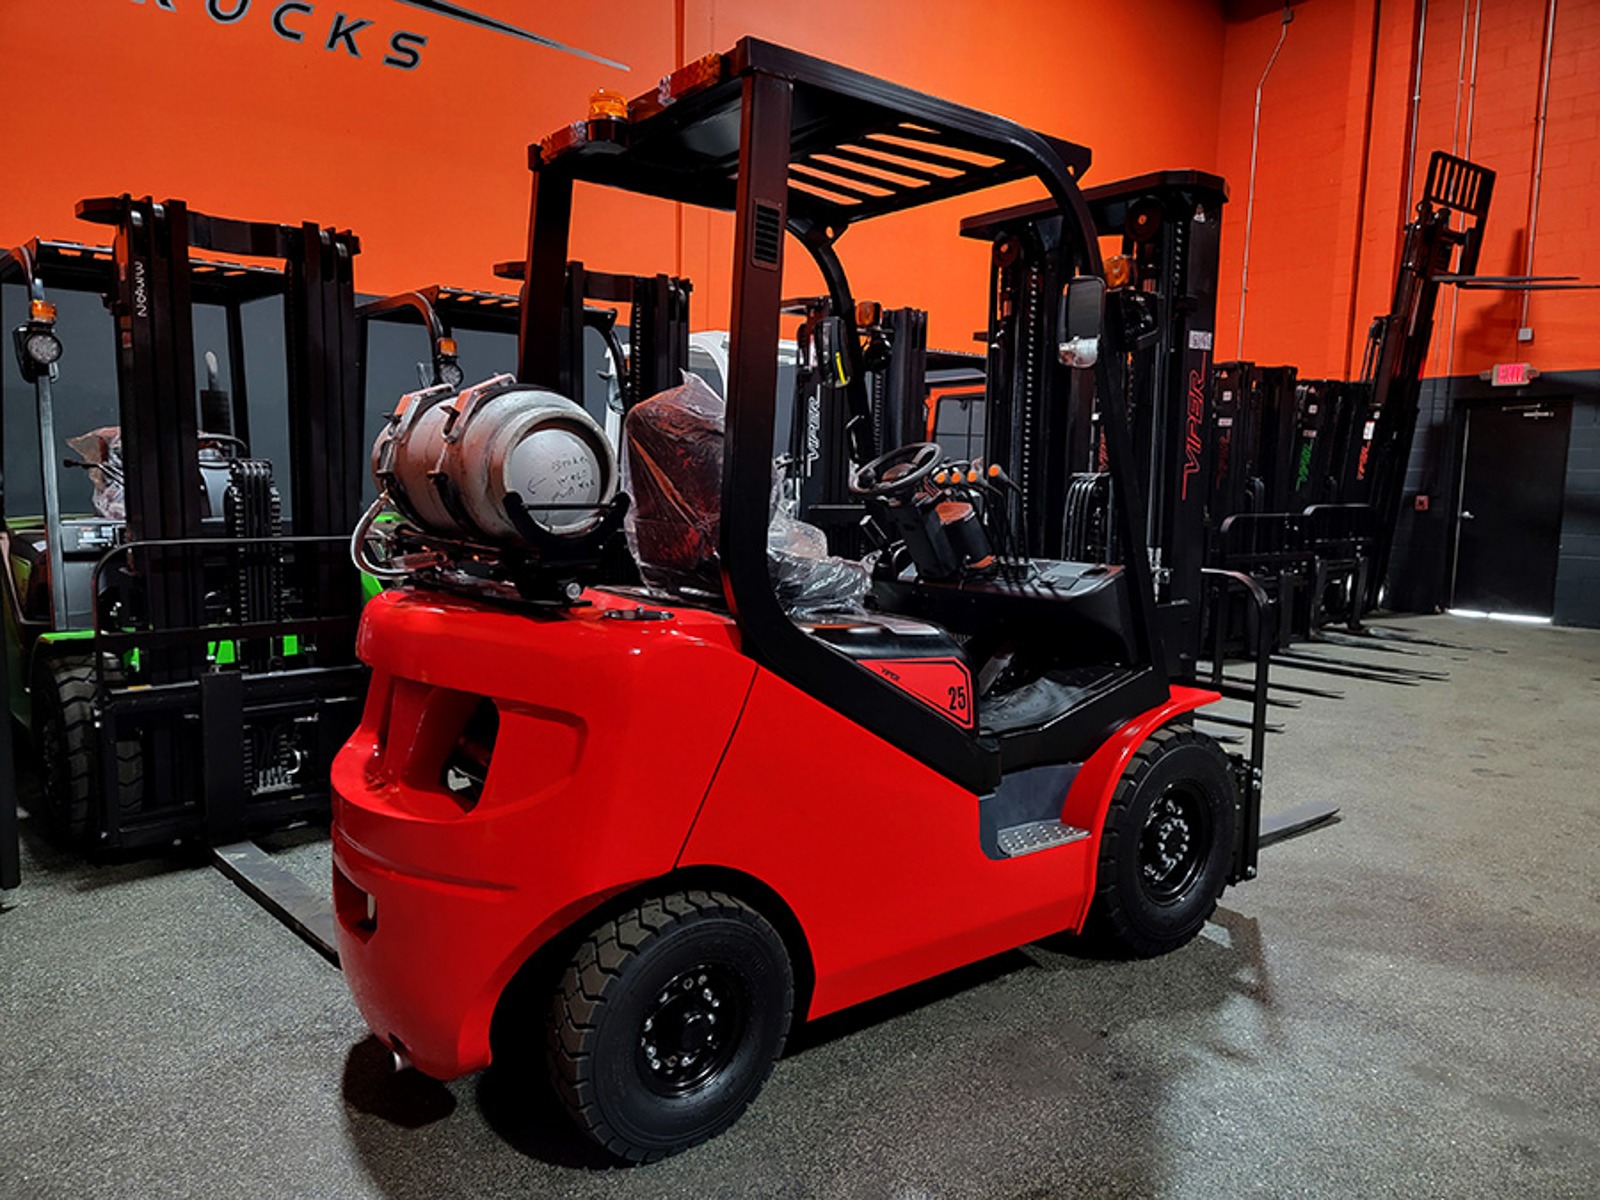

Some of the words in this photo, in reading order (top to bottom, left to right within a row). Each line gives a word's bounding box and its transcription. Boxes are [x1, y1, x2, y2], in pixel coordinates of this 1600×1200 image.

[130, 0, 428, 71] UCKS
[1498, 364, 1526, 383] EXIT
[1182, 351, 1207, 501] VIPER
[948, 686, 966, 710] 25
